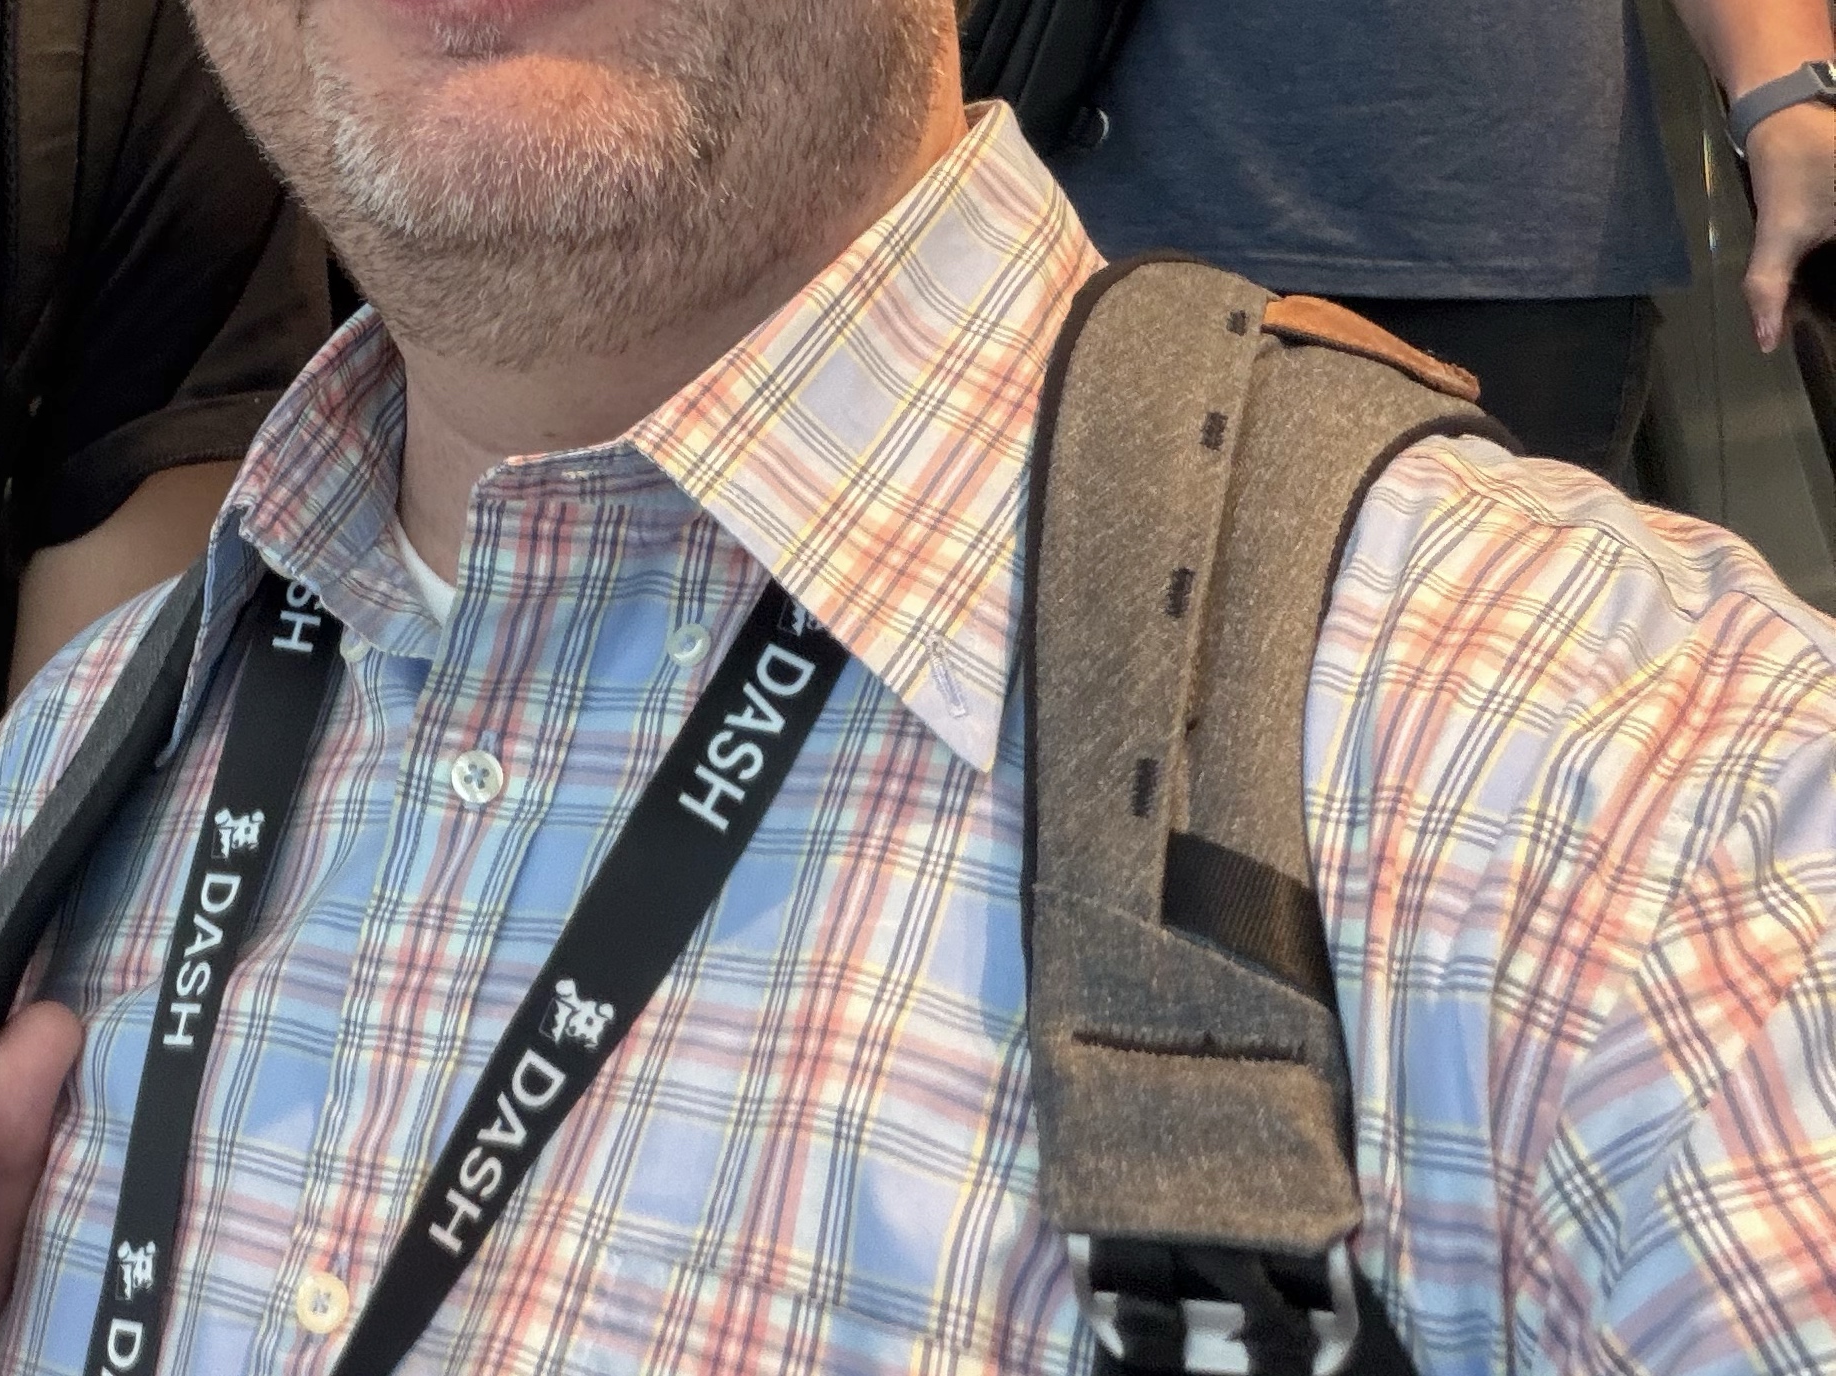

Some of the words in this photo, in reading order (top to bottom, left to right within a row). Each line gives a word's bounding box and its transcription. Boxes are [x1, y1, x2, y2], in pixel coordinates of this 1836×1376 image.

[678, 644, 814, 831] DASH
[162, 873, 241, 1048] DASH
[428, 1050, 566, 1253] DASH
[101, 1318, 143, 1376] D
